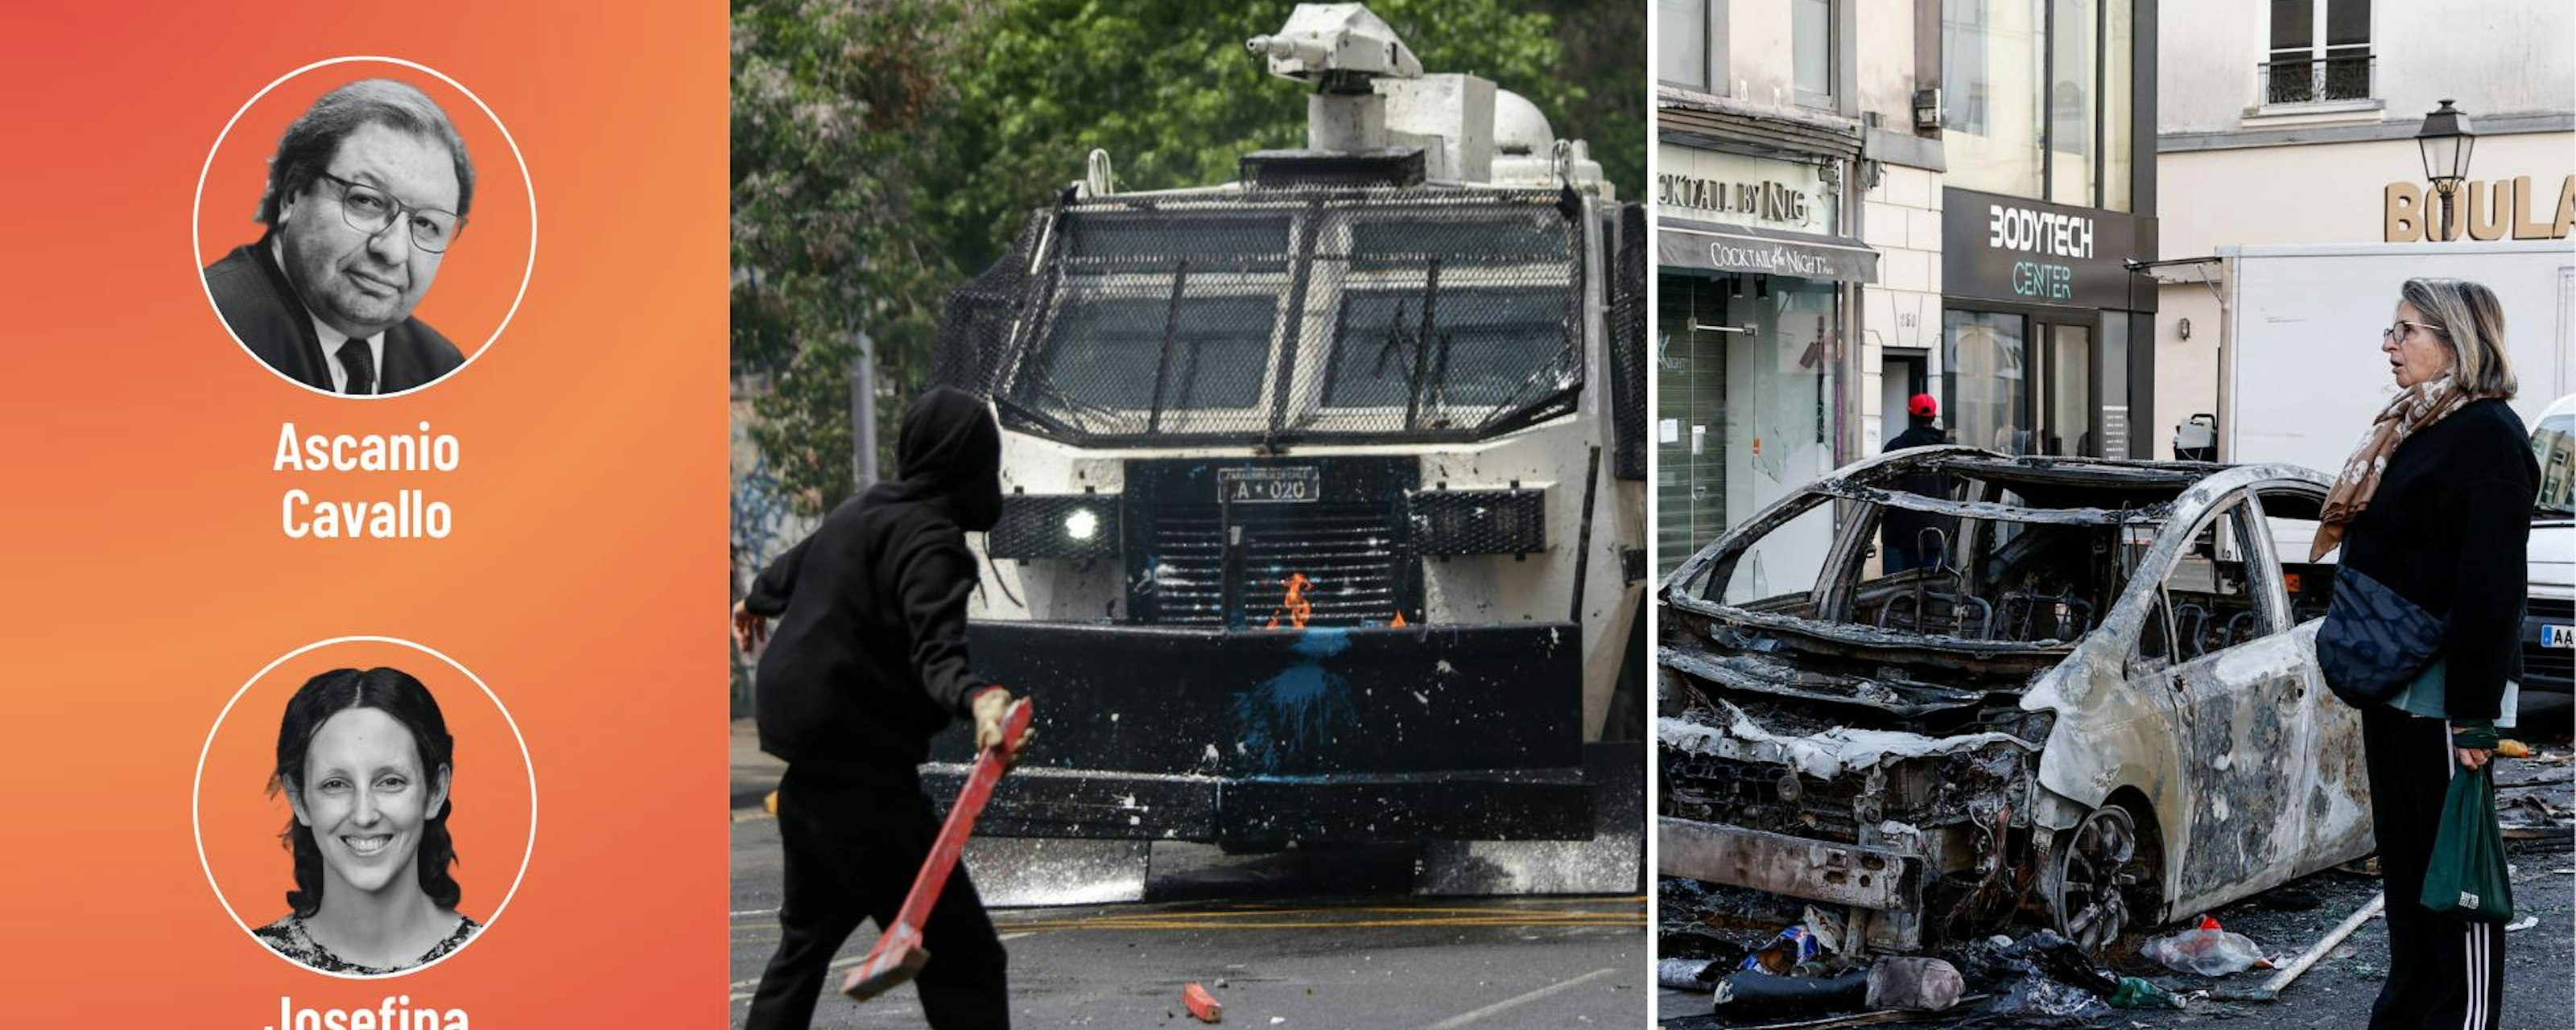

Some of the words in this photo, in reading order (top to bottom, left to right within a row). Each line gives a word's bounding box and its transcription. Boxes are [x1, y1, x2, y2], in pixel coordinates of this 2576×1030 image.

[1736, 182, 1760, 214] BY
[1990, 204, 2093, 259] BODYTECH
[2013, 262, 2071, 299] CENTER
[1270, 480, 1305, 499] 020
[2554, 629, 2574, 645] AA
